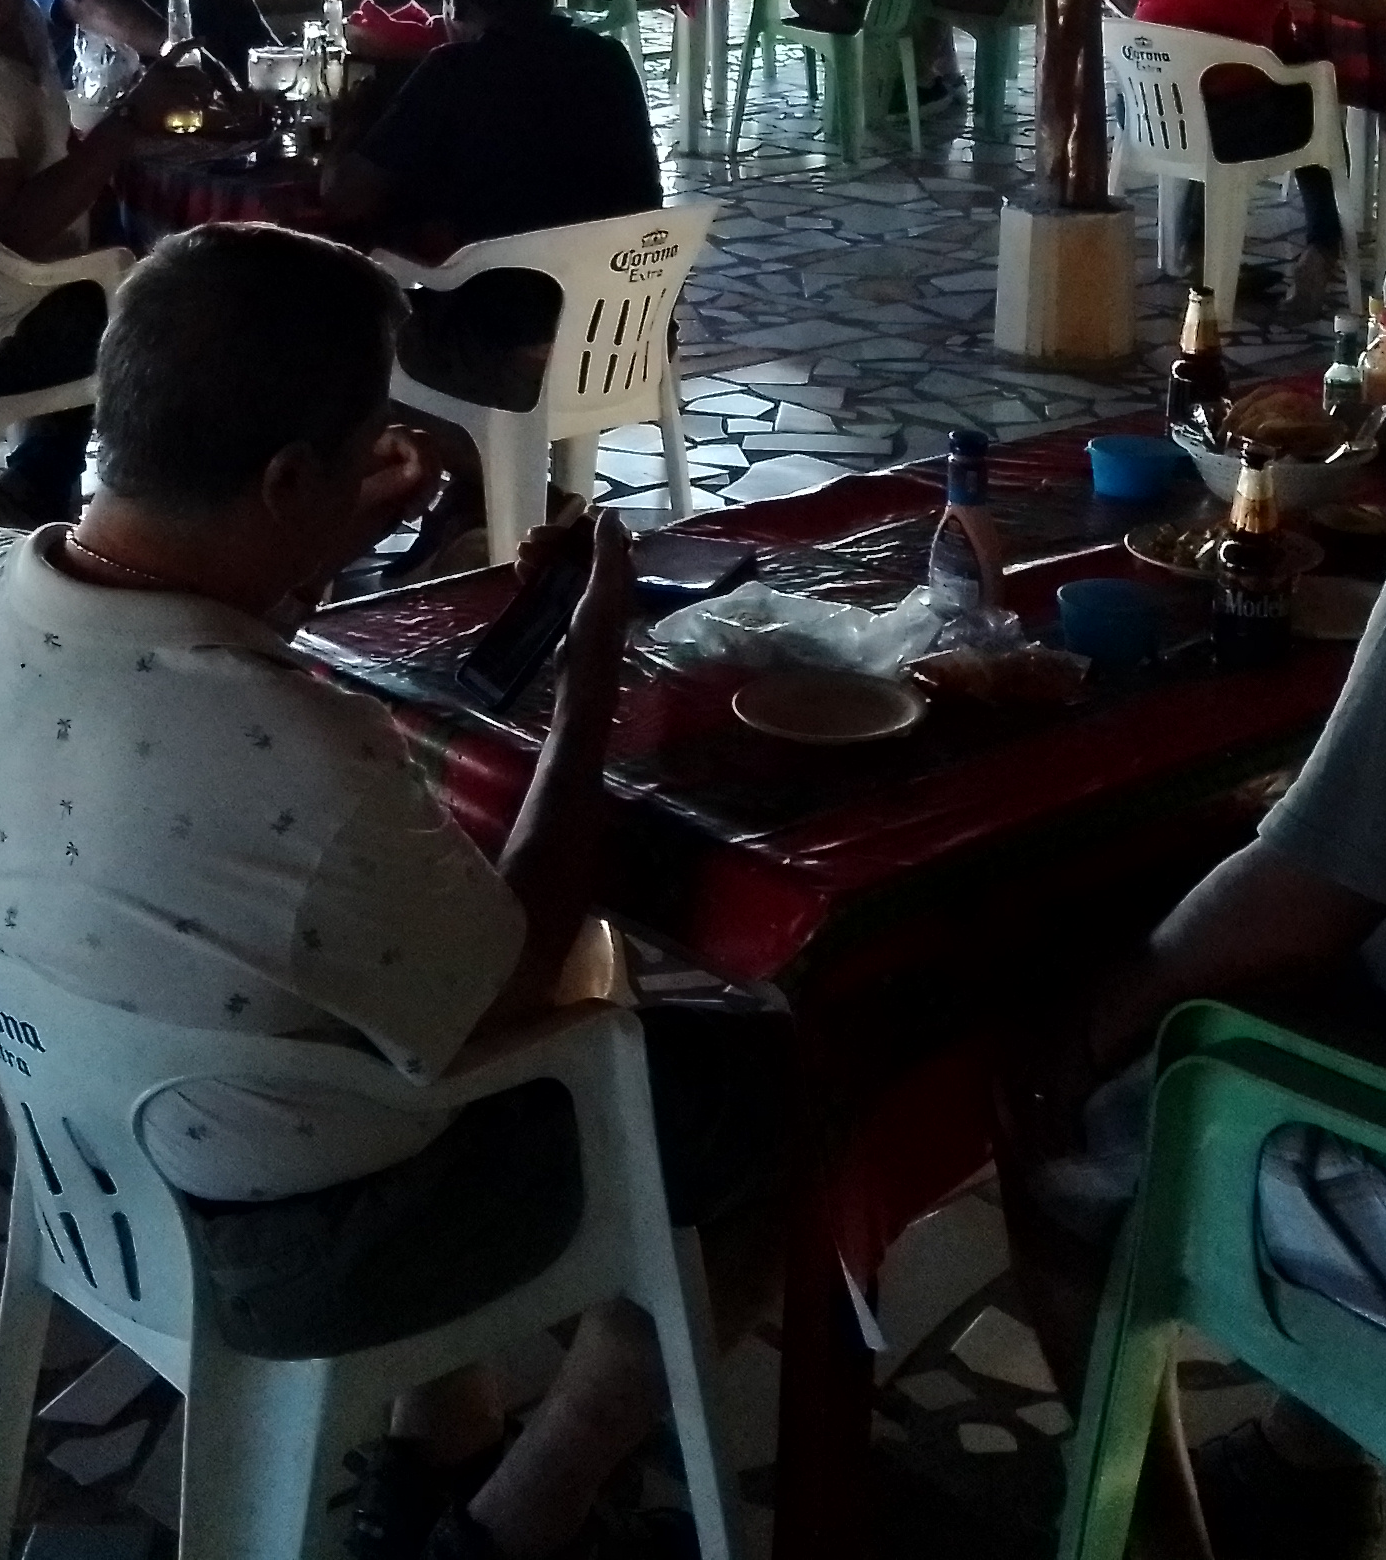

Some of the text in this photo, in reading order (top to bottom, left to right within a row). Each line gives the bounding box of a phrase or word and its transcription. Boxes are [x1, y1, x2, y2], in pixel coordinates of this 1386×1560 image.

[1121, 45, 1171, 62] Corona
[609, 243, 680, 273] Corona
[628, 268, 664, 283] Extra
